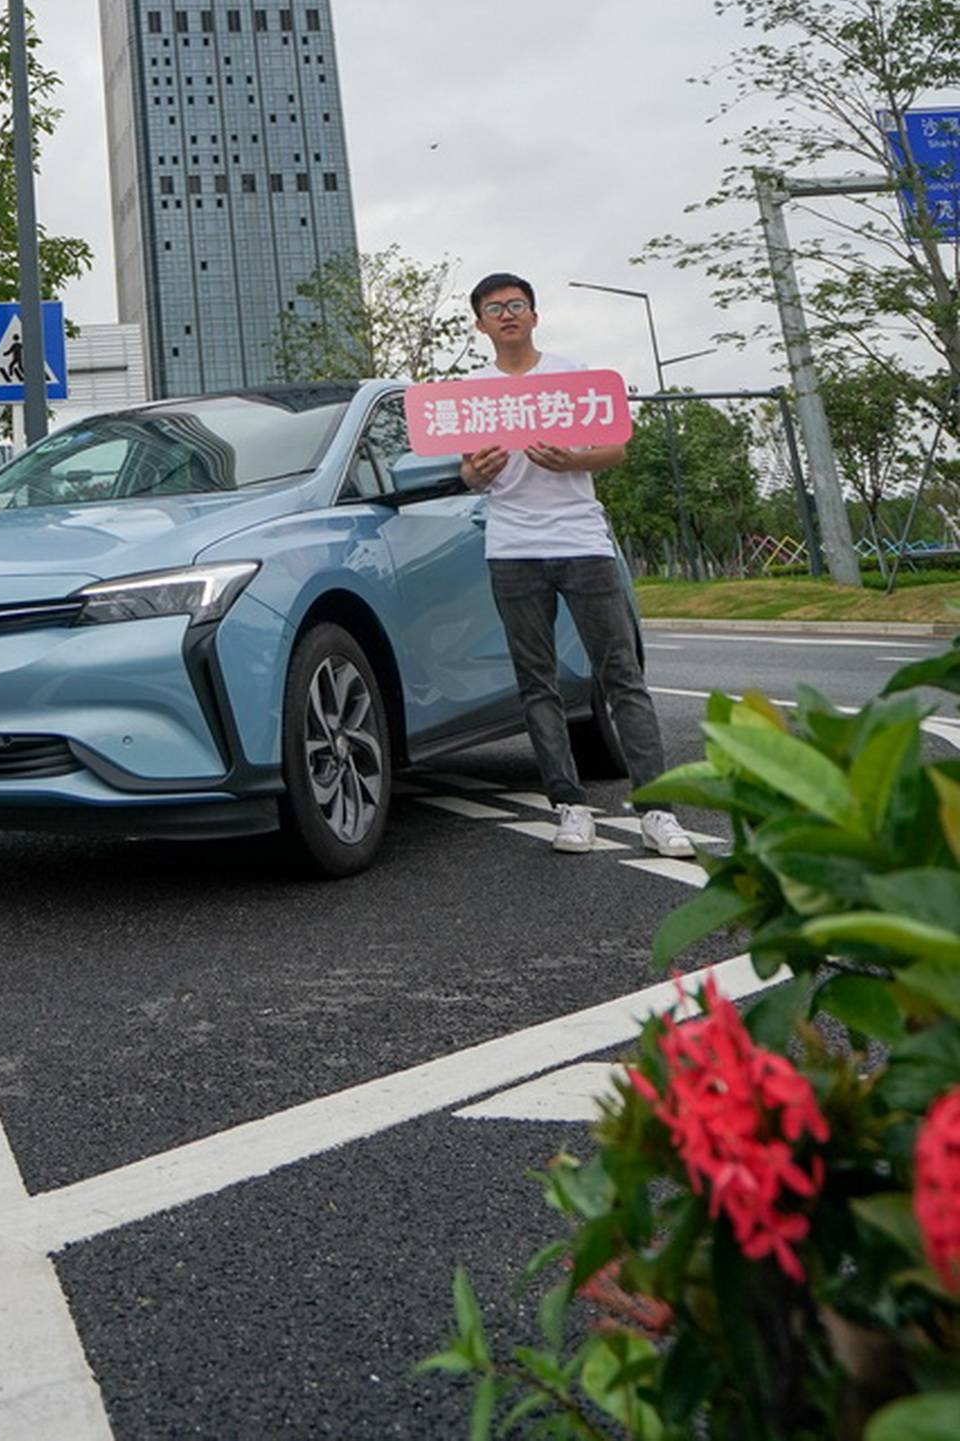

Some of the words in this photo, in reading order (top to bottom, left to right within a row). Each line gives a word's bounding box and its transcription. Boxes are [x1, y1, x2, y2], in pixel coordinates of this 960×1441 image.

[424, 388, 614, 436] 漫游新势力
